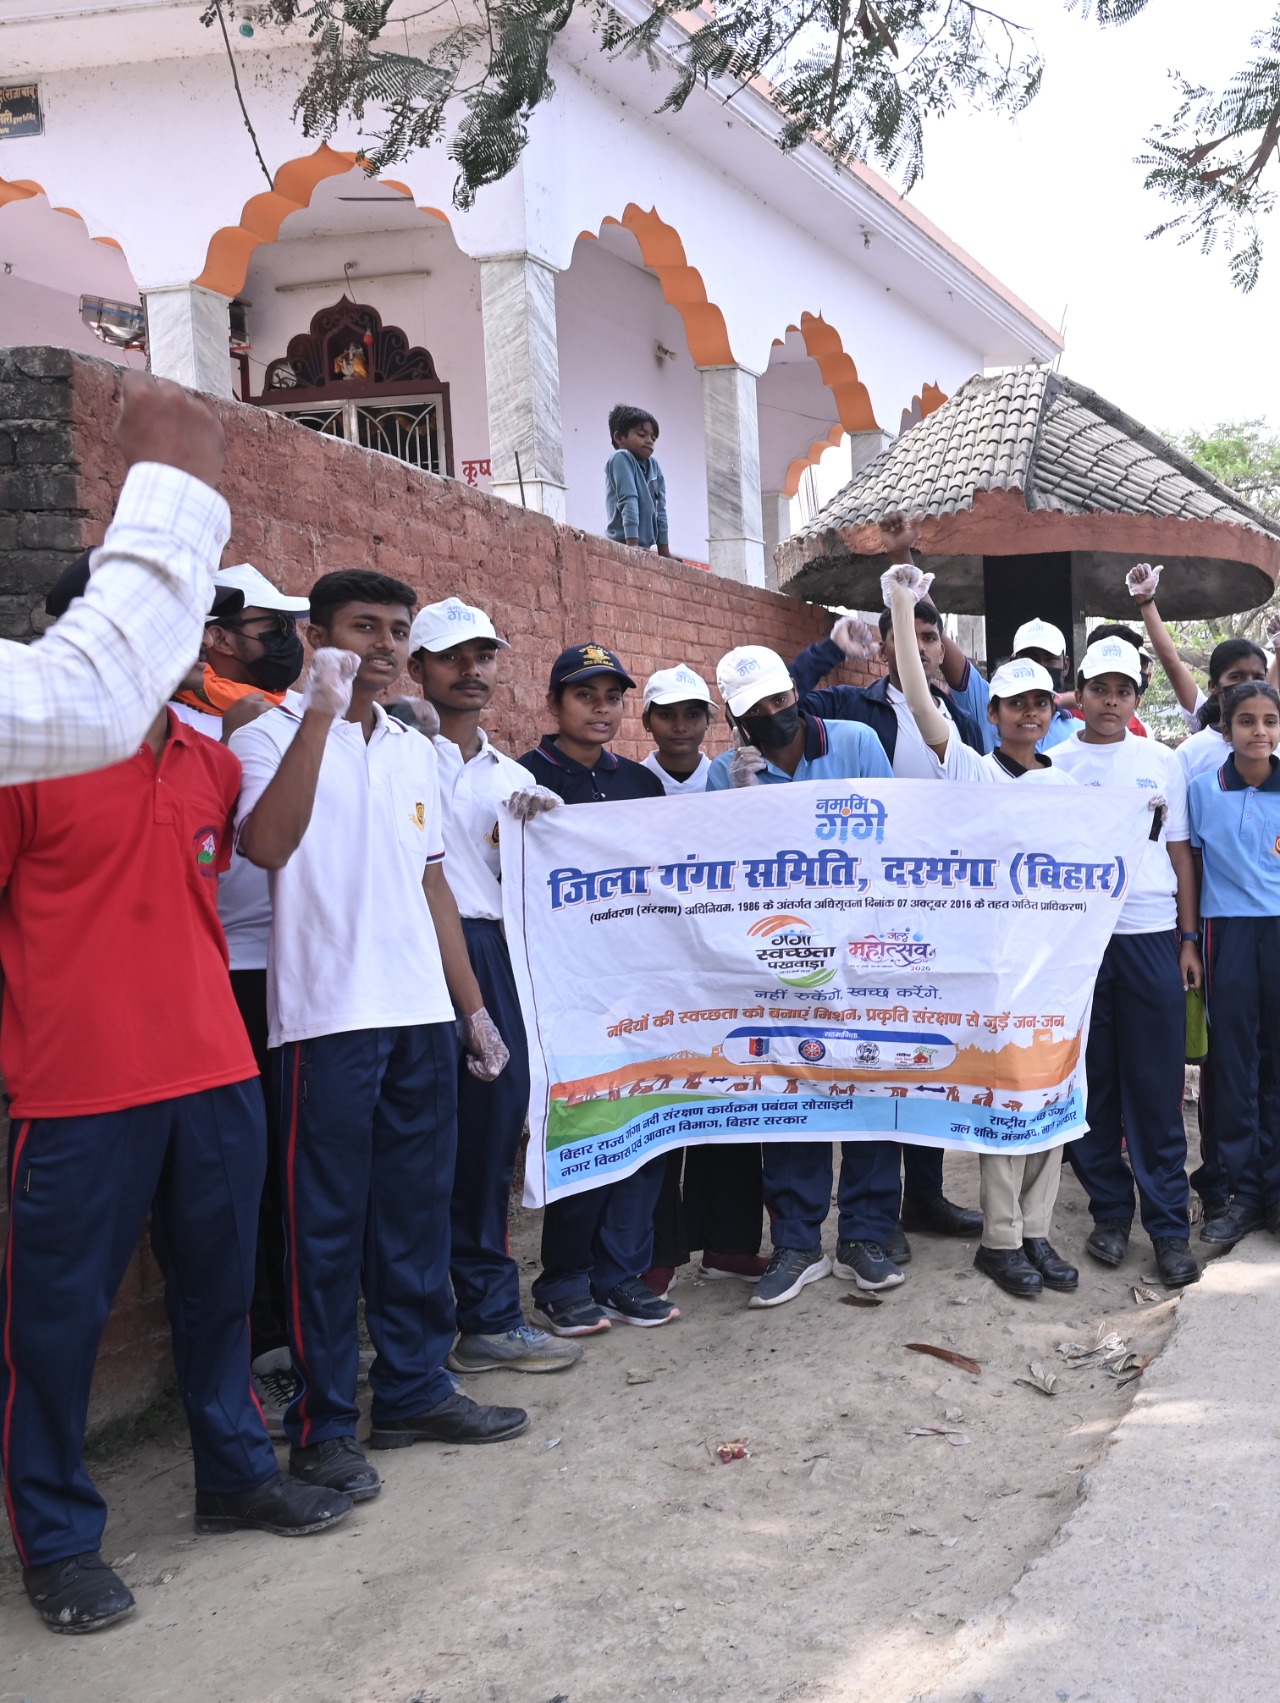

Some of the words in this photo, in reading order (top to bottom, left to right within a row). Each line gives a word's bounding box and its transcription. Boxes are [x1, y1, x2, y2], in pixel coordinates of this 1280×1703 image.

[815, 794, 868, 813] नमामि
[815, 799, 888, 844] गंगे
[547, 867, 652, 909] जिला
[658, 854, 736, 892] गंगा
[742, 849, 868, 892] समिति,
[881, 850, 997, 888] दरभंगा
[1009, 852, 1127, 899] (बिहार)
[590, 907, 634, 924] (पर्यावरण
[637, 904, 682, 916] (संरक्षण)
[685, 902, 734, 915] अधिनियम,
[738, 902, 760, 911] 1986
[763, 900, 774, 911] के
[777, 898, 811, 909] अंतर्गत
[815, 898, 862, 911] अधिसूचना
[865, 897, 894, 908] दिनांक
[897, 899, 907, 908] 07
[910, 899, 947, 911] अक्टूबर
[950, 899, 971, 908] 2016
[974, 898, 985, 909] के
[987, 900, 1009, 909] तहत
[1012, 899, 1038, 910] गठित
[1041, 900, 1087, 913] प्राधिकरण)
[756, 947, 837, 961] स्वच्छता
[767, 960, 825, 970] पखवाड़ा
[754, 988, 788, 1000] नहीं
[847, 987, 890, 999] स्वच्छ
[606, 1013, 650, 1038] नदियों
[652, 1009, 674, 1027] की
[678, 1008, 738, 1024] स्वच्छता
[742, 1005, 765, 1019] को
[768, 1006, 811, 1021] बनाएं
[813, 1007, 861, 1021] मिशन,
[865, 1006, 909, 1025] प्रकृति
[912, 1006, 962, 1026] संरक्षण
[966, 1010, 979, 1027] से
[983, 1011, 1011, 1034] जुड़ें
[1013, 1015, 1065, 1029] जन-जन
[560, 1143, 593, 1162] बिहार
[597, 1134, 625, 1151] राज्य
[625, 1122, 641, 1141] गंगा
[643, 1114, 659, 1130] नदी
[662, 1104, 703, 1122] संरक्षण
[707, 1101, 758, 1116] कार्यक्रम
[761, 1099, 798, 1113] प्रबंधन
[801, 1098, 854, 1111] सोसाइटी
[950, 1123, 970, 1134] जल
[973, 1126, 999, 1140] शक्ति
[990, 1115, 1027, 1131] राष्ट्रीय
[560, 1160, 591, 1178] नगर
[594, 1149, 631, 1168] विकास
[630, 1137, 642, 1155] एवं
[643, 1126, 676, 1146] आवास
[679, 1118, 723, 1132] विभाग,
[726, 1114, 759, 1129] बिहार
[763, 1114, 808, 1126] सरकार
